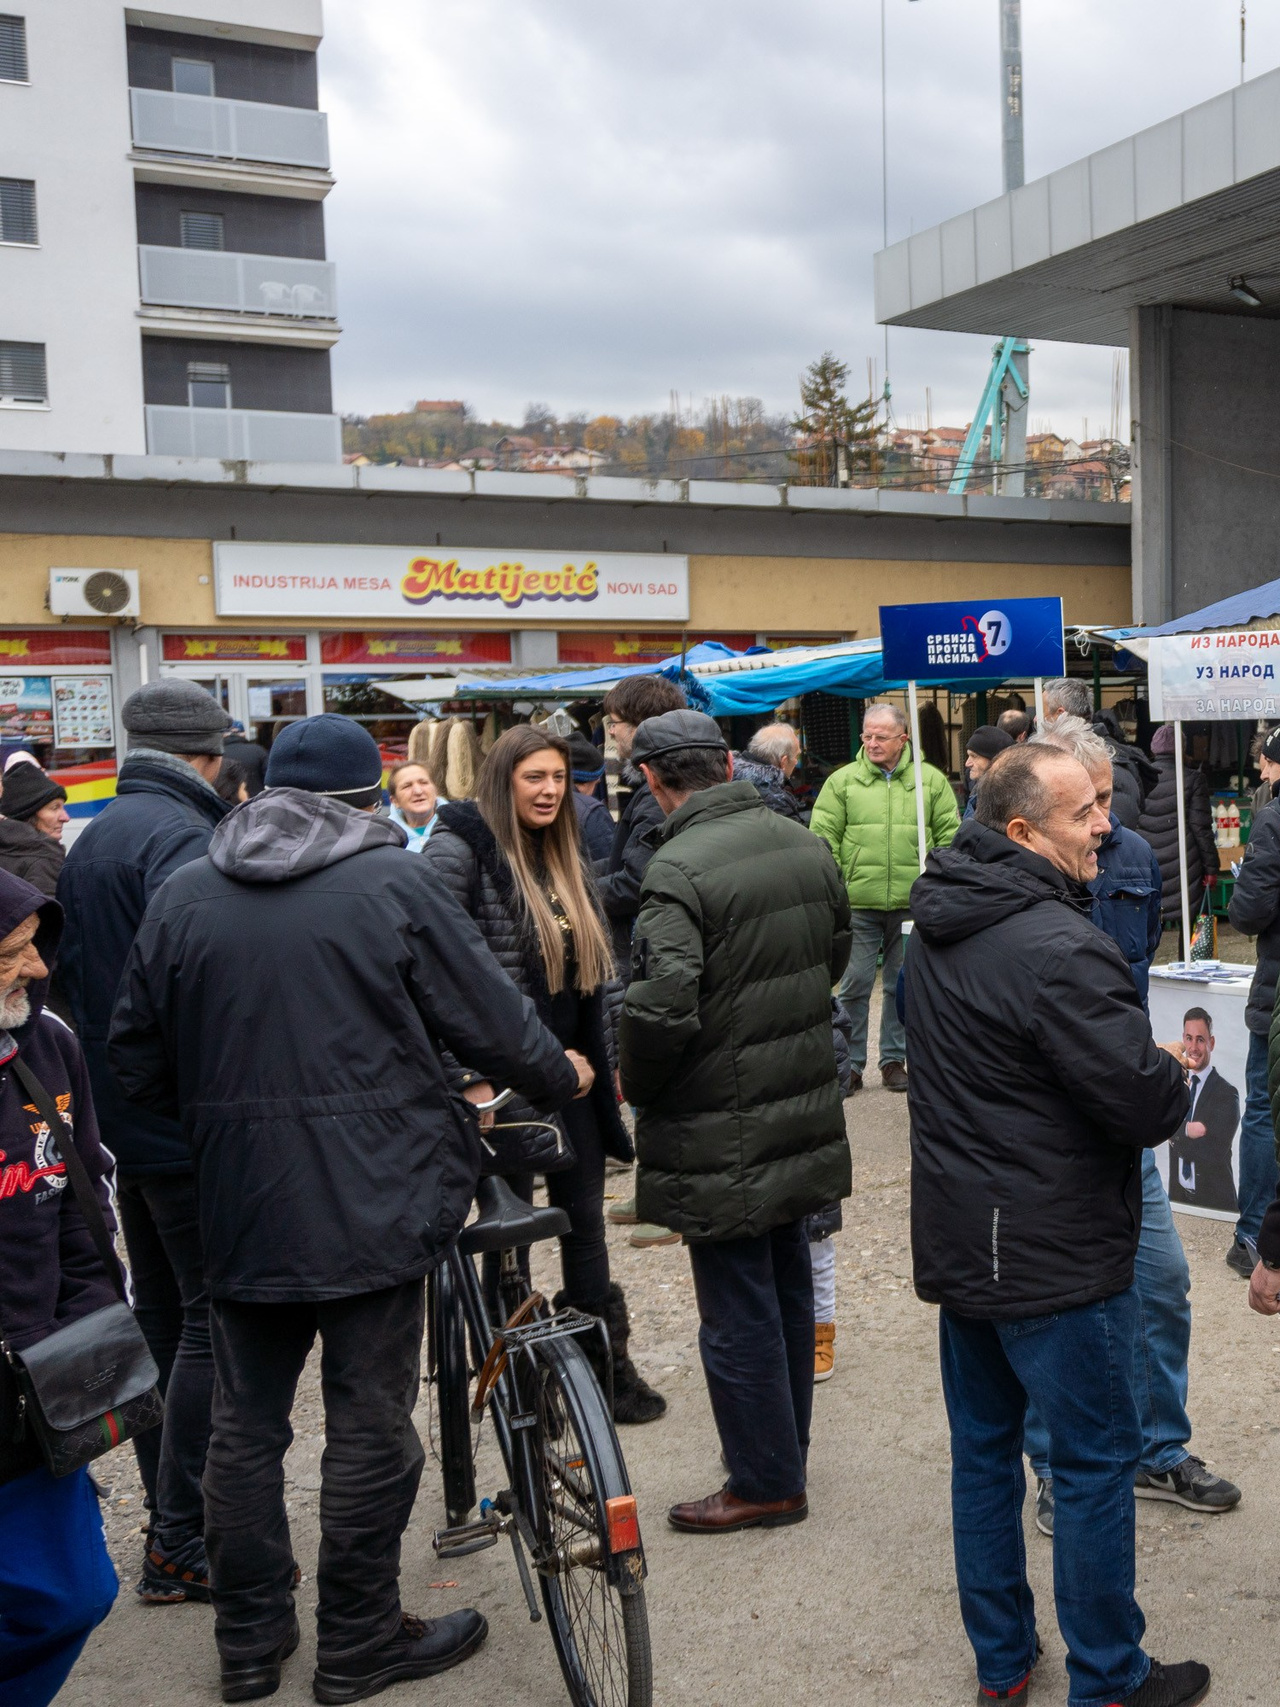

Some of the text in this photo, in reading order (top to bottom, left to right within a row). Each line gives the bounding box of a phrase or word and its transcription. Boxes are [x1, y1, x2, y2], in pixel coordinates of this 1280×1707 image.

[233, 557, 678, 604] INDUSTRIJA MESA Matijević NOVI SAD
[927, 634, 975, 644] СРБИЈА
[987, 621, 1006, 646] 7.
[1191, 633, 1280, 649] ИЗ НАРОДА
[927, 643, 976, 654] ПРОТИВ
[928, 653, 978, 664] НАСИЉА
[1196, 664, 1275, 679] УЗ НАРОД
[1196, 697, 1276, 714] ЗА НАРОД
